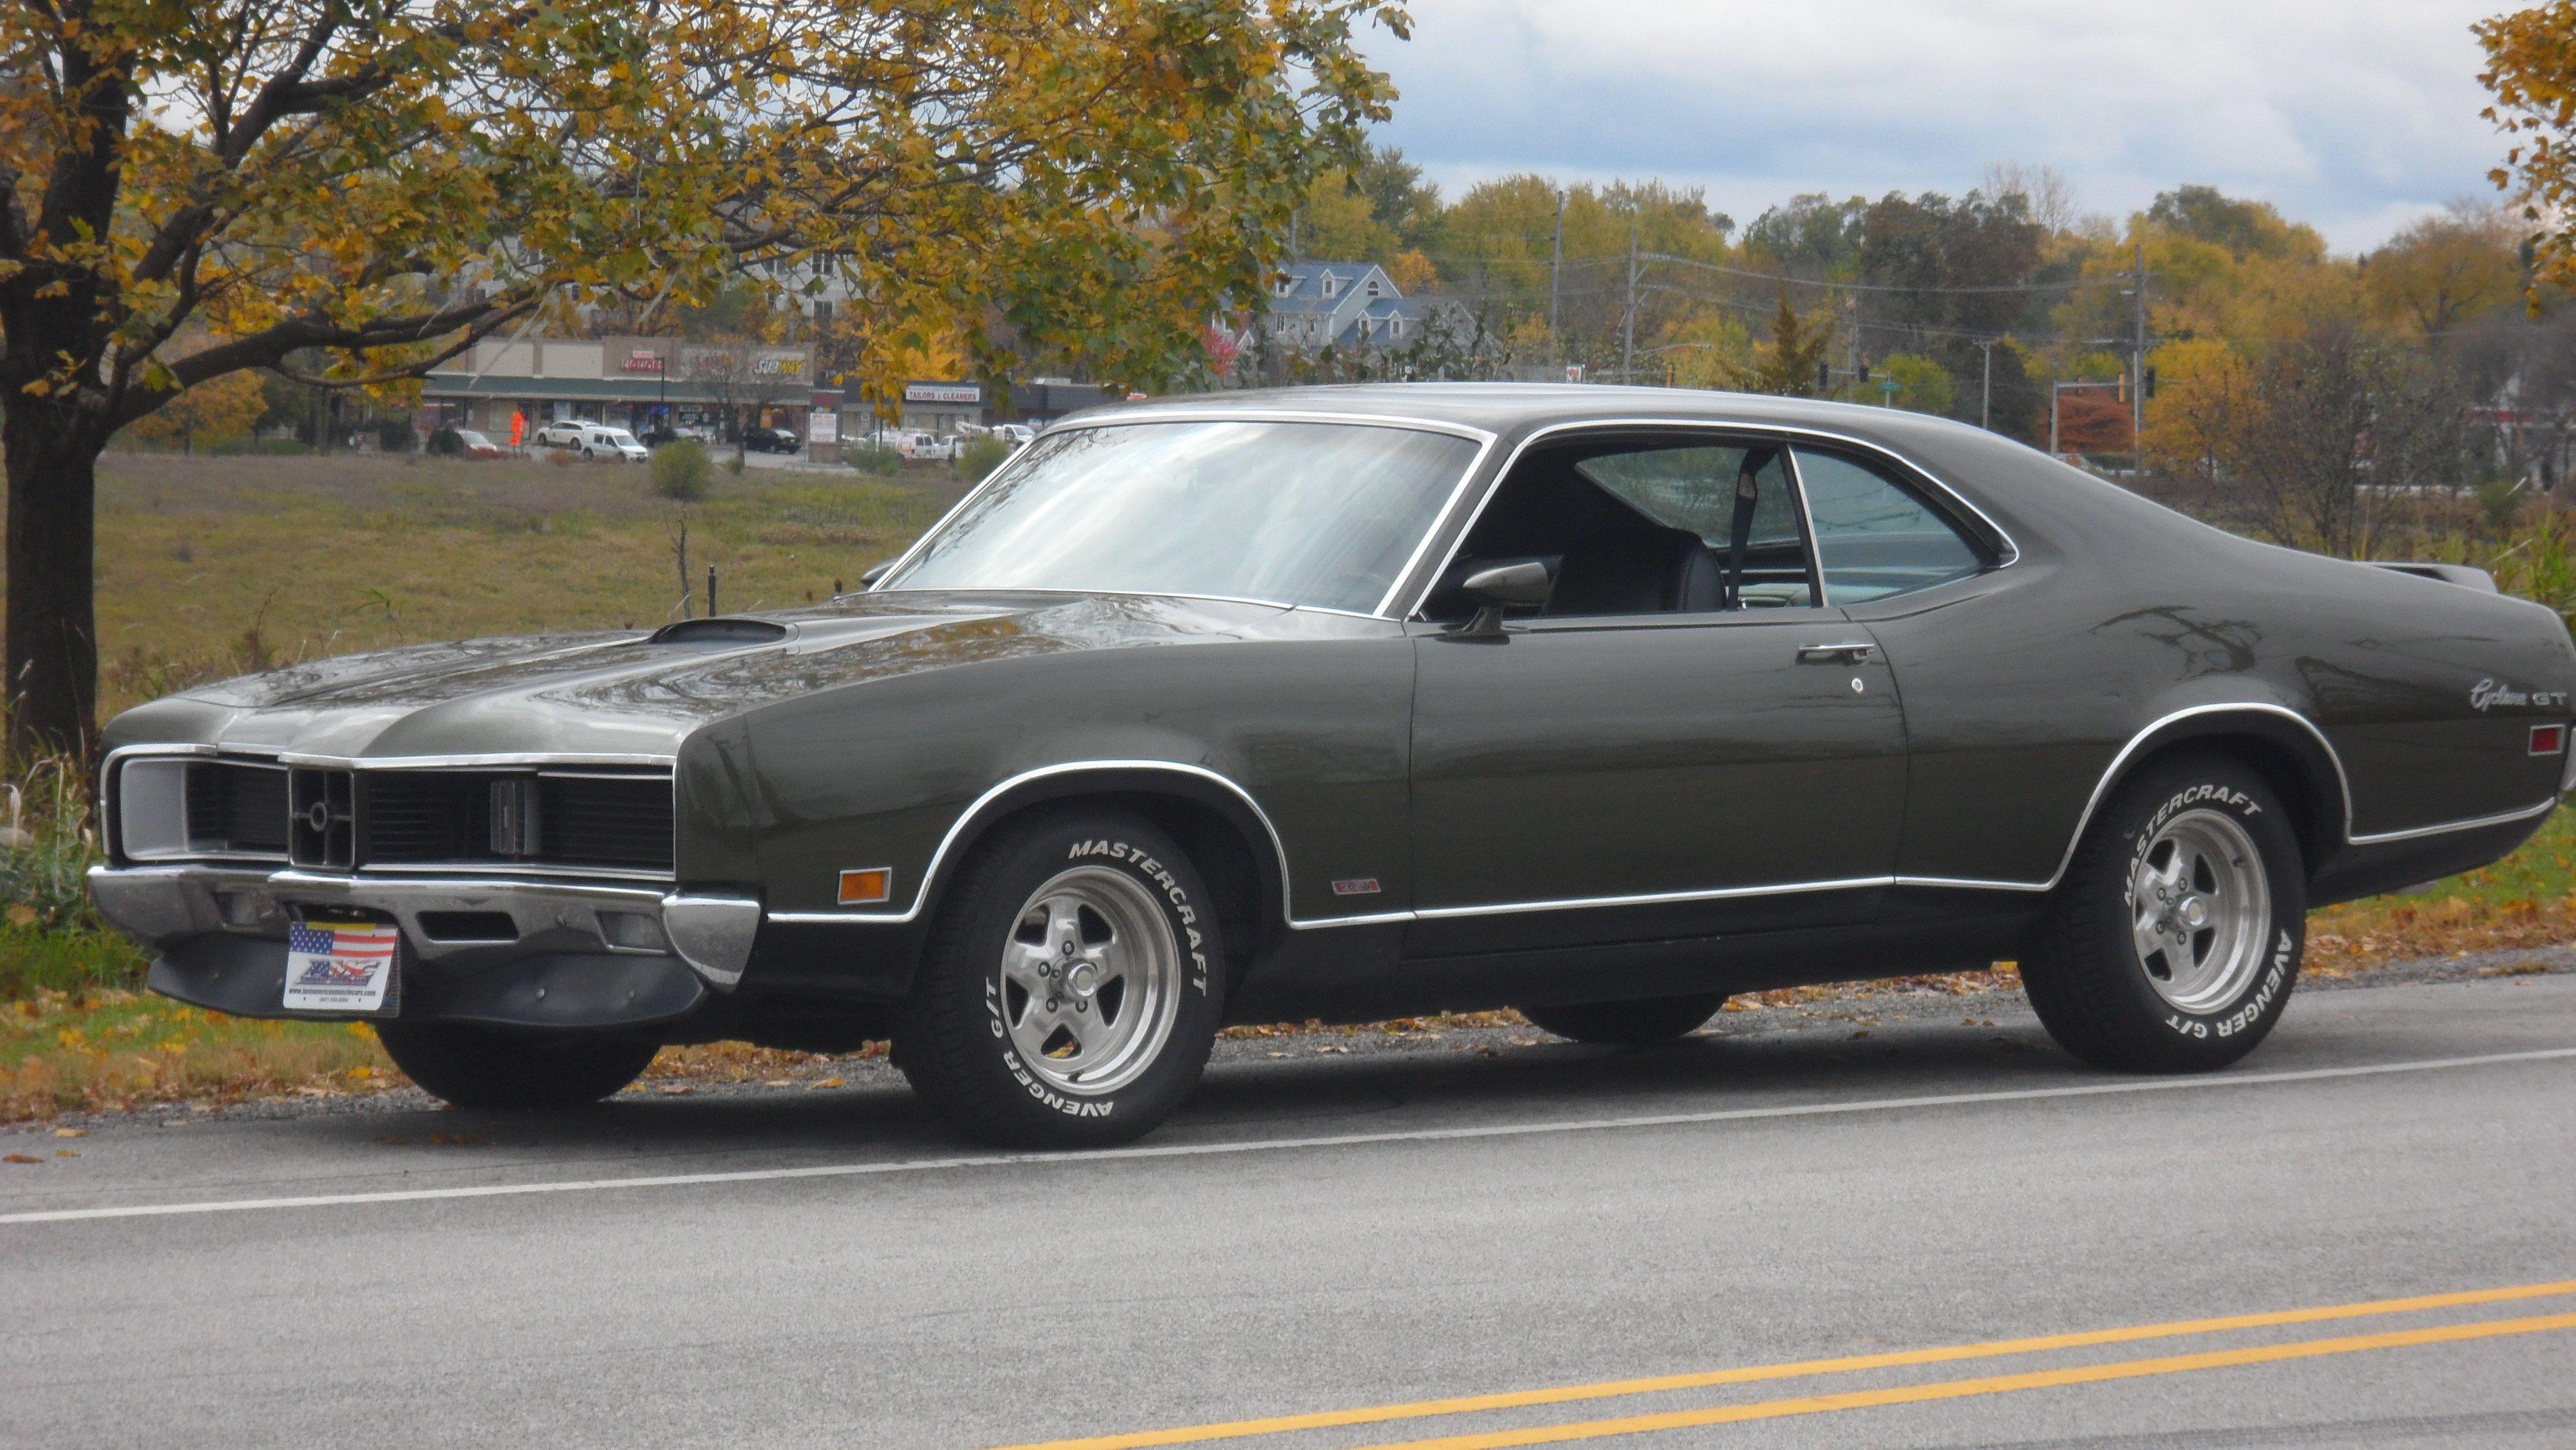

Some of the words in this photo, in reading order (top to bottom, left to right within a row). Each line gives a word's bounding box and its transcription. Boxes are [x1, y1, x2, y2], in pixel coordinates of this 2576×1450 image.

[754, 359, 806, 375] SUBWAY
[909, 391, 935, 400] TAILORS
[943, 392, 977, 401] CLEANERS
[2533, 692, 2567, 705] GT
[2125, 785, 2262, 907] MASTERCRAFT
[1068, 839, 1207, 997] MASTERCRAFT
[2217, 929, 2293, 1037] AVENGER
[1004, 1051, 1114, 1117] AVENGER
